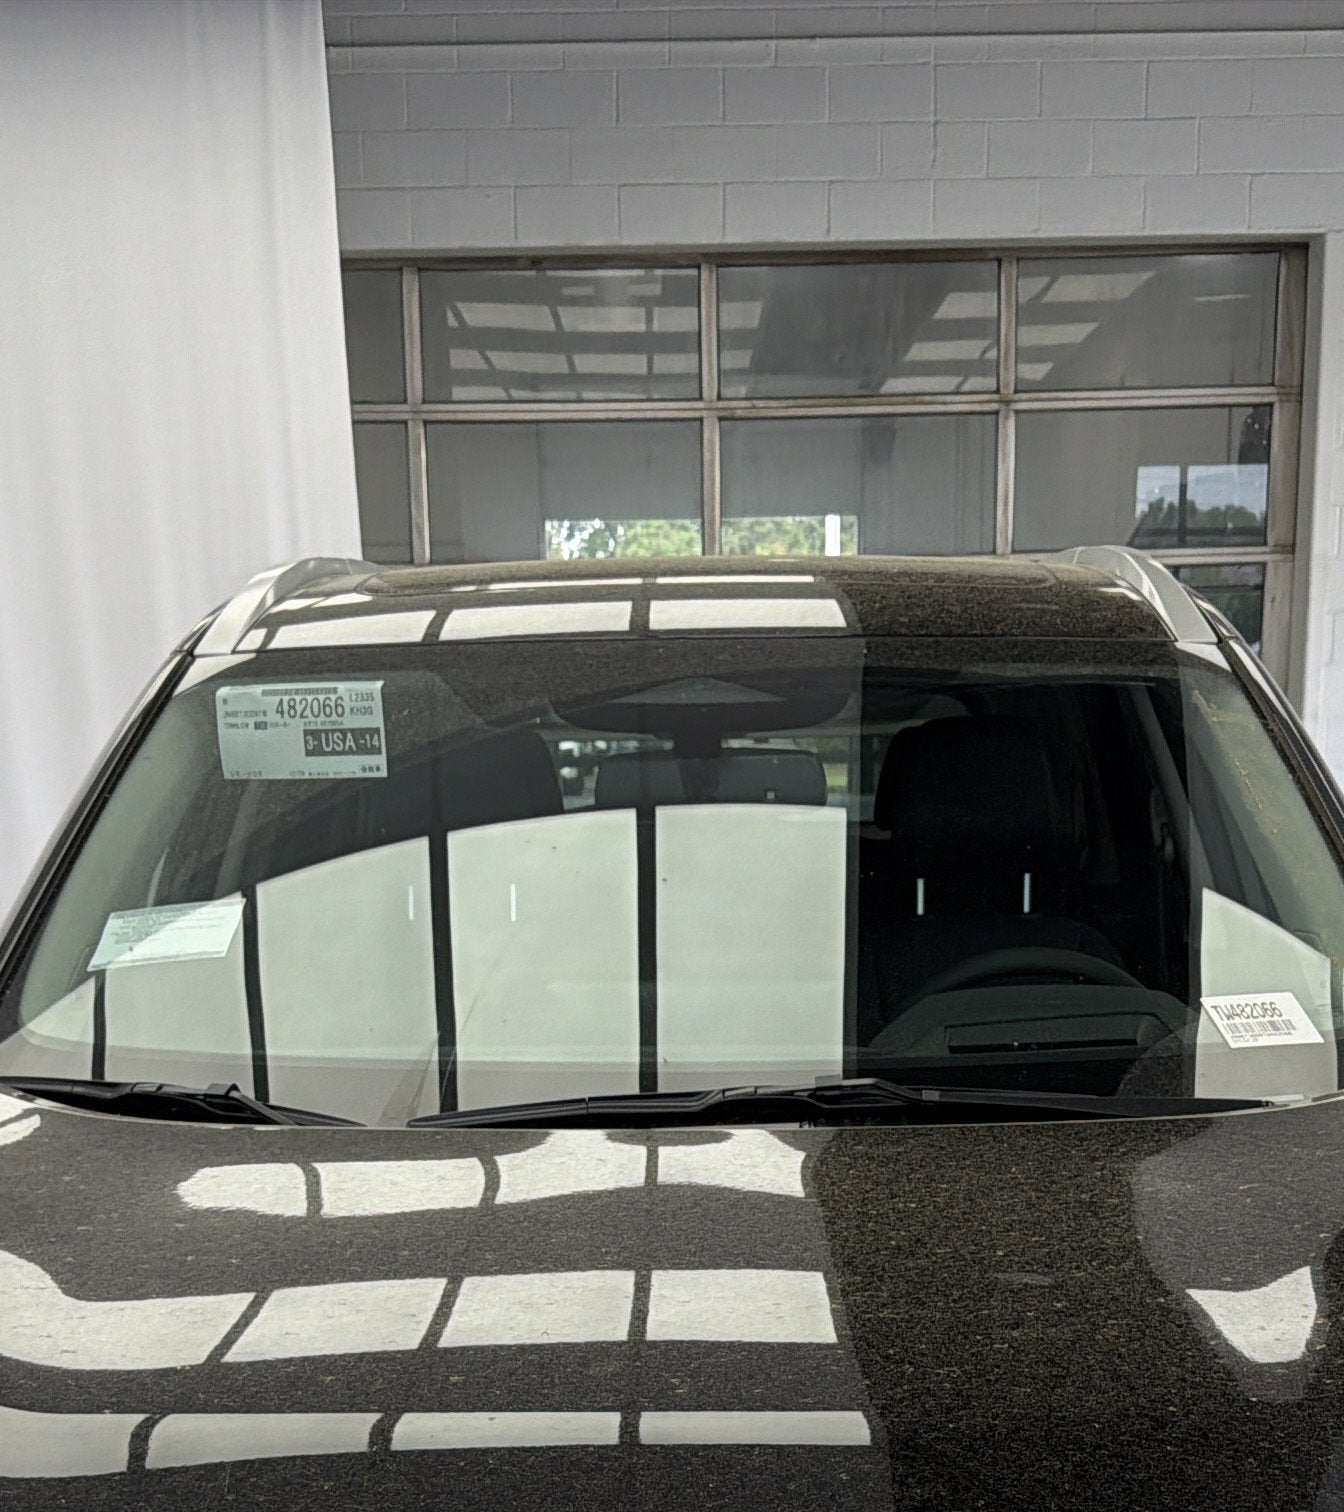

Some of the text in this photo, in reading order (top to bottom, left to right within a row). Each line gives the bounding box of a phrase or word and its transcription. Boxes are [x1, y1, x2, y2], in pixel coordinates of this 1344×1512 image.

[275, 697, 346, 719] 482066
[322, 733, 357, 752] USA
[1210, 1001, 1284, 1022] TW482066
